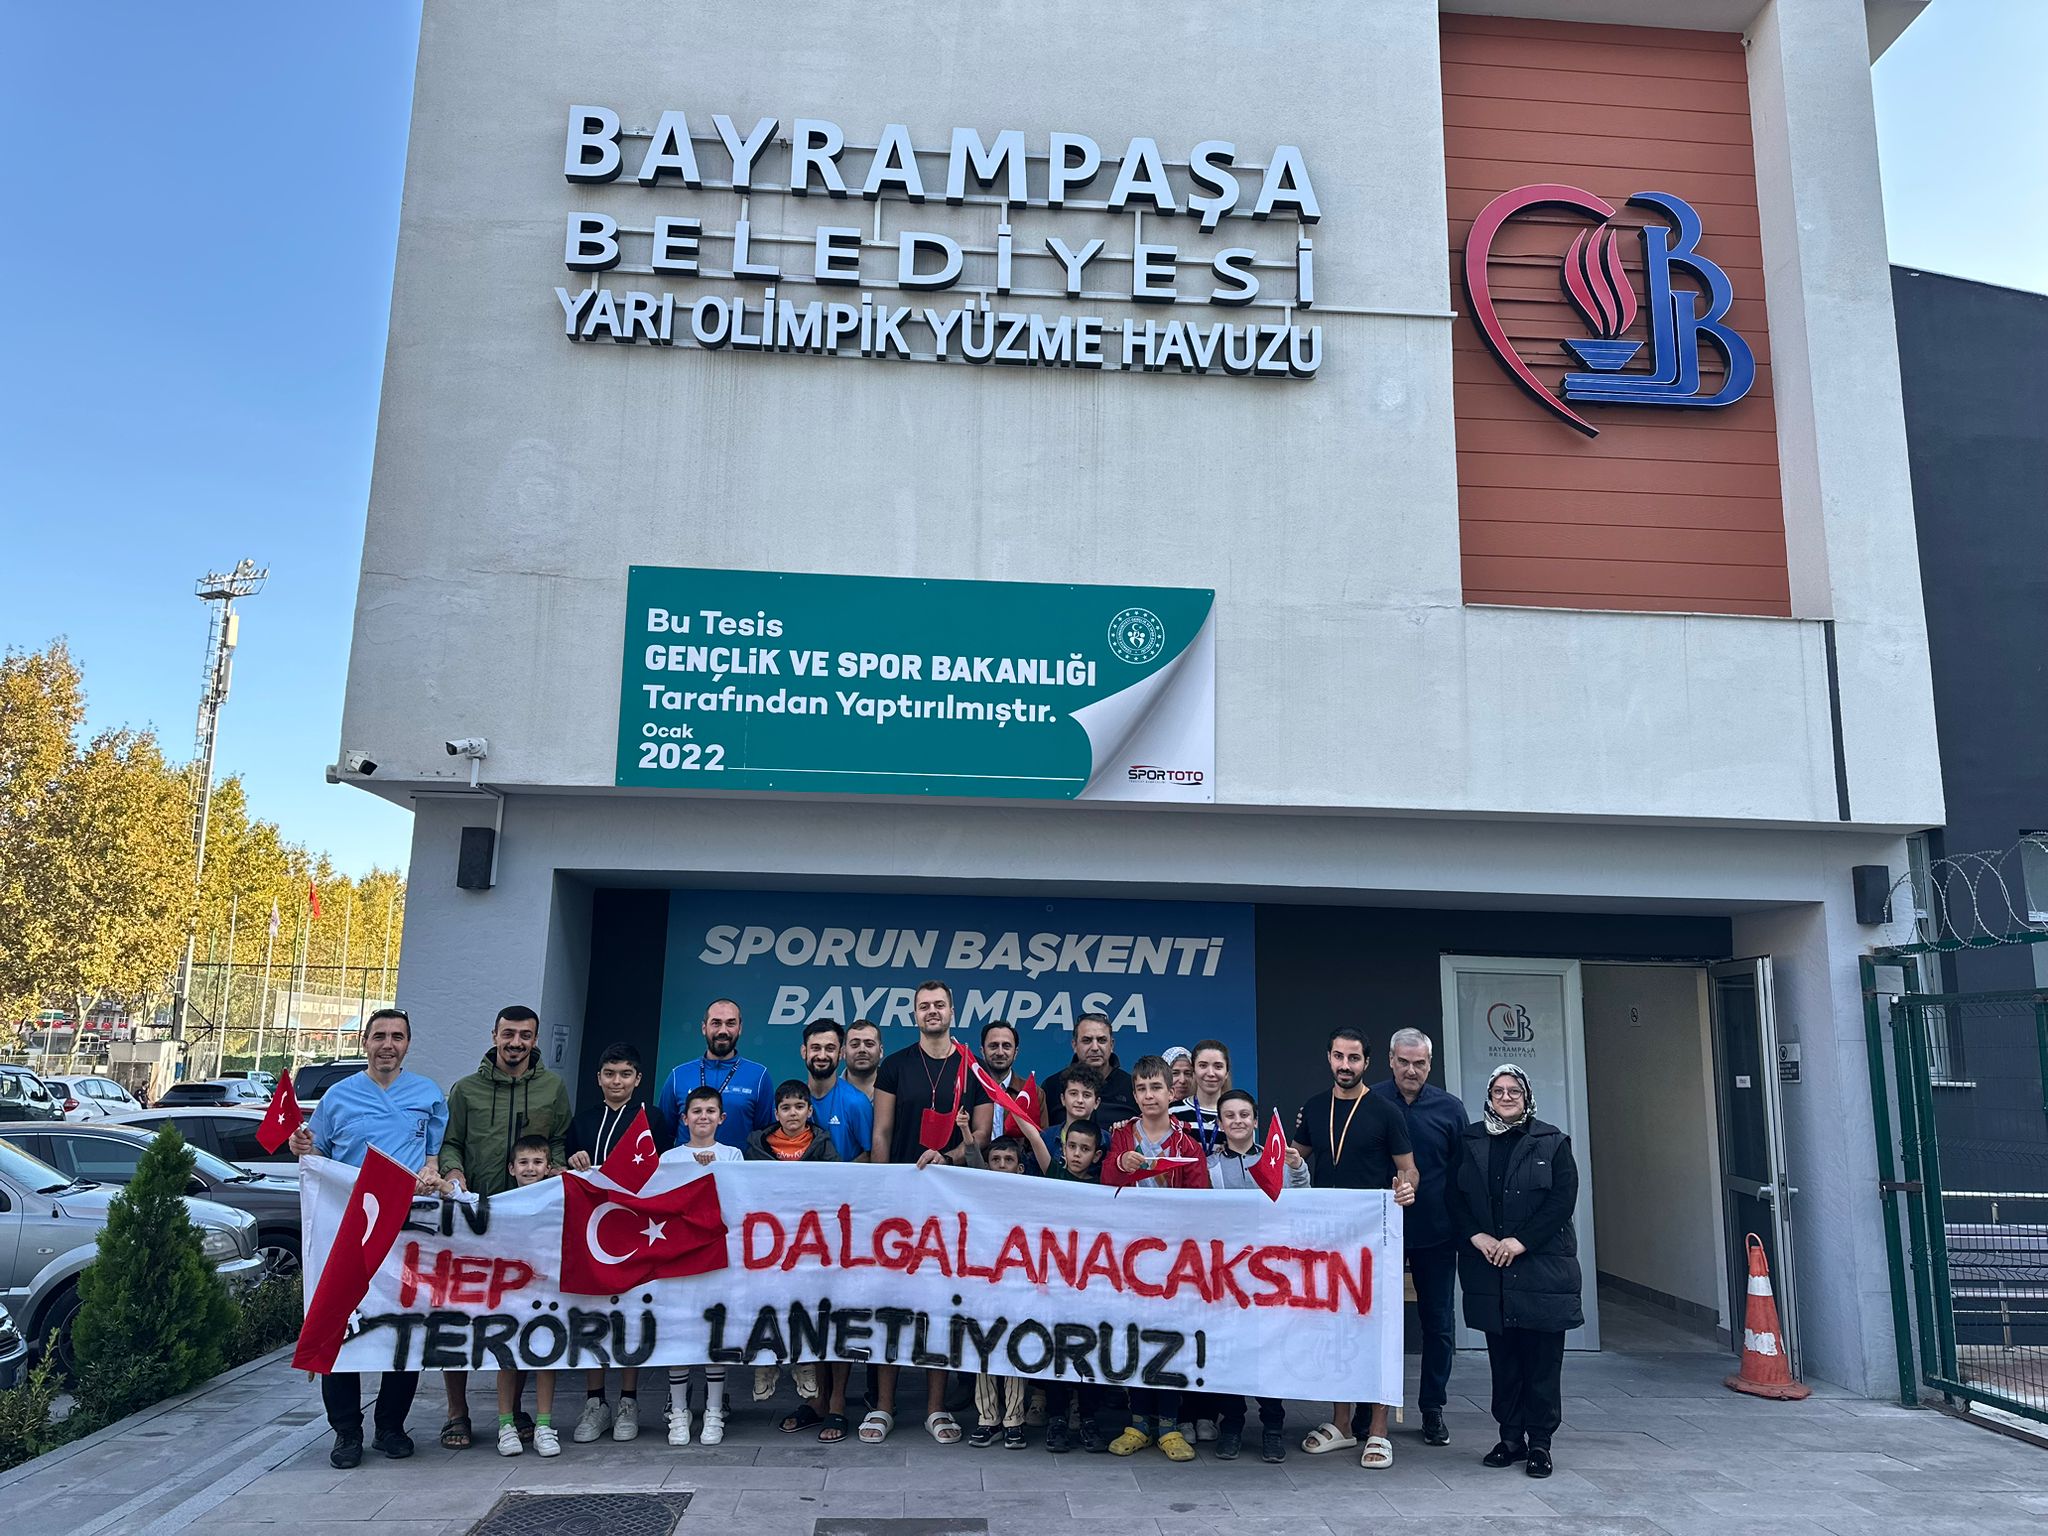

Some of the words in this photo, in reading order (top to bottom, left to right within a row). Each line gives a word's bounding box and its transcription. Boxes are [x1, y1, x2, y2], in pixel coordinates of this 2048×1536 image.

[564, 104, 1321, 233] BAYRAMPAŞA
[565, 211, 1313, 309] BELEDİYESİ
[554, 287, 675, 345] YARI
[691, 287, 912, 360] OLİMPİK
[923, 299, 1103, 369] YÜZME
[1122, 318, 1322, 377] HAVUZU
[647, 608, 690, 633] Bu
[700, 610, 783, 637] Tesis
[645, 644, 781, 683] GENÇLİK
[789, 650, 829, 677] VE
[837, 652, 922, 680] SPOR
[932, 652, 1096, 686] BAKANLIĞI
[642, 684, 828, 715] Tarafından
[836, 691, 1056, 727] Yaptırılmıştır.
[642, 722, 693, 738] Ocak
[638, 742, 725, 771] 2022
[698, 925, 939, 968] SPORUN
[945, 931, 1225, 980] BAŞKENTİ
[767, 985, 1149, 1033] BAYRMPAA
[401, 1184, 491, 1237] EN
[400, 1241, 536, 1310] HEP
[742, 1203, 1373, 1315] DALGALANACAKSIN
[362, 1293, 656, 1371] TERÖRÜ
